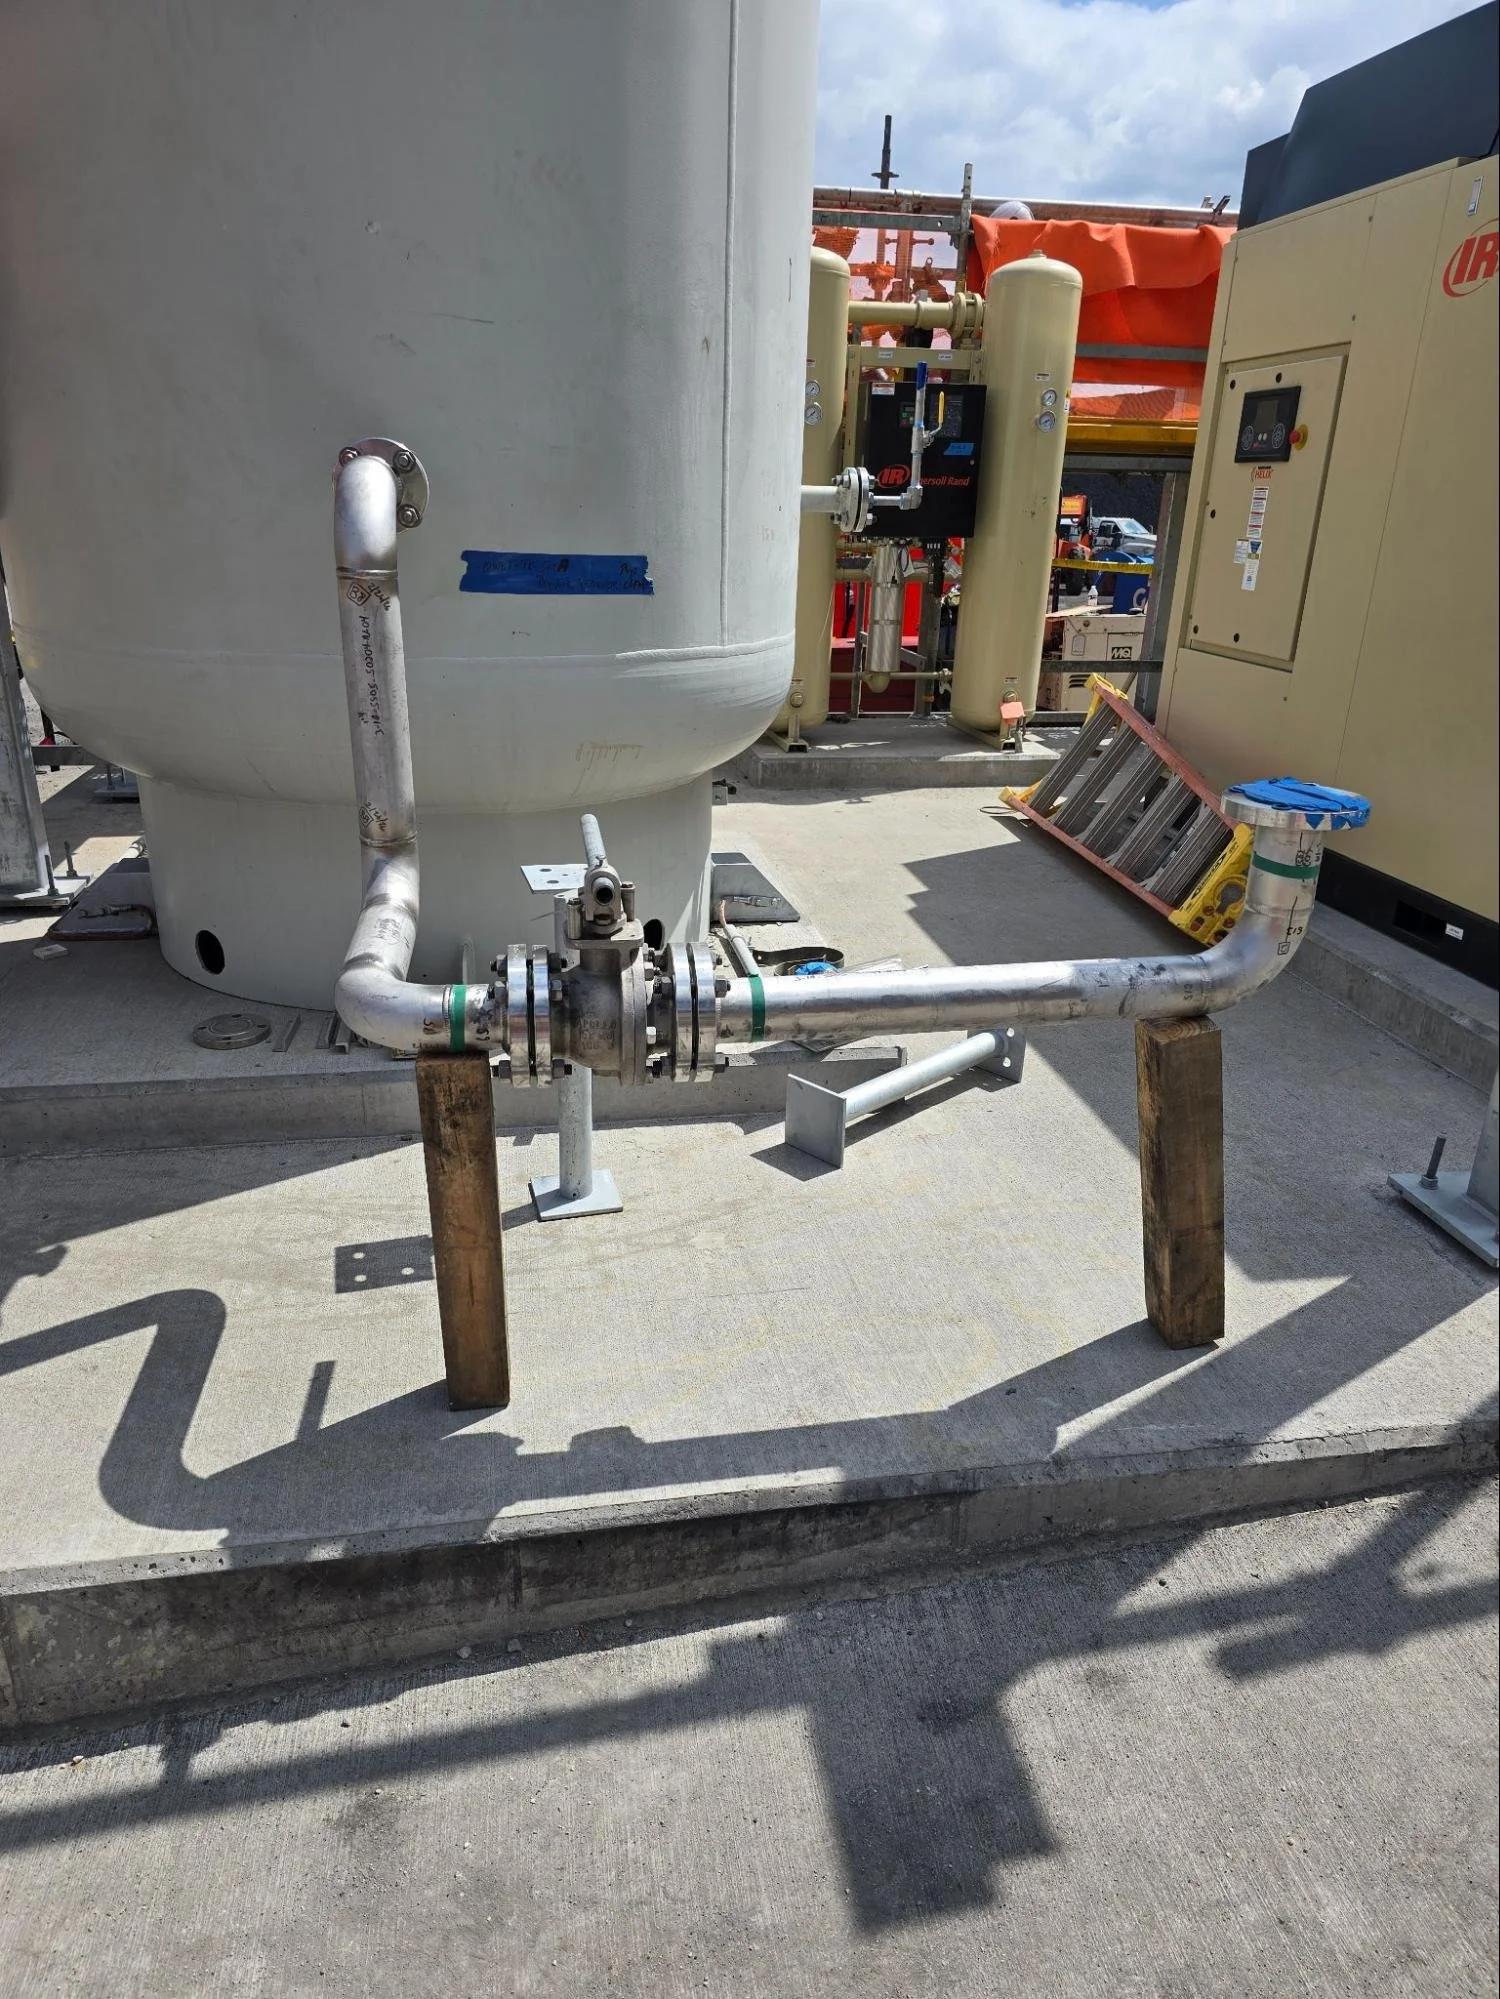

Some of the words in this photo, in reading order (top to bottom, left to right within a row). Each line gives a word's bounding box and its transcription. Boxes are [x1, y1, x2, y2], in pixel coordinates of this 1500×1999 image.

[1451, 232, 1499, 285] IR
[881, 468, 905, 485] IR
[920, 476, 947, 487] ersoll
[948, 476, 970, 487] Rand
[1112, 647, 1132, 659] MQ
